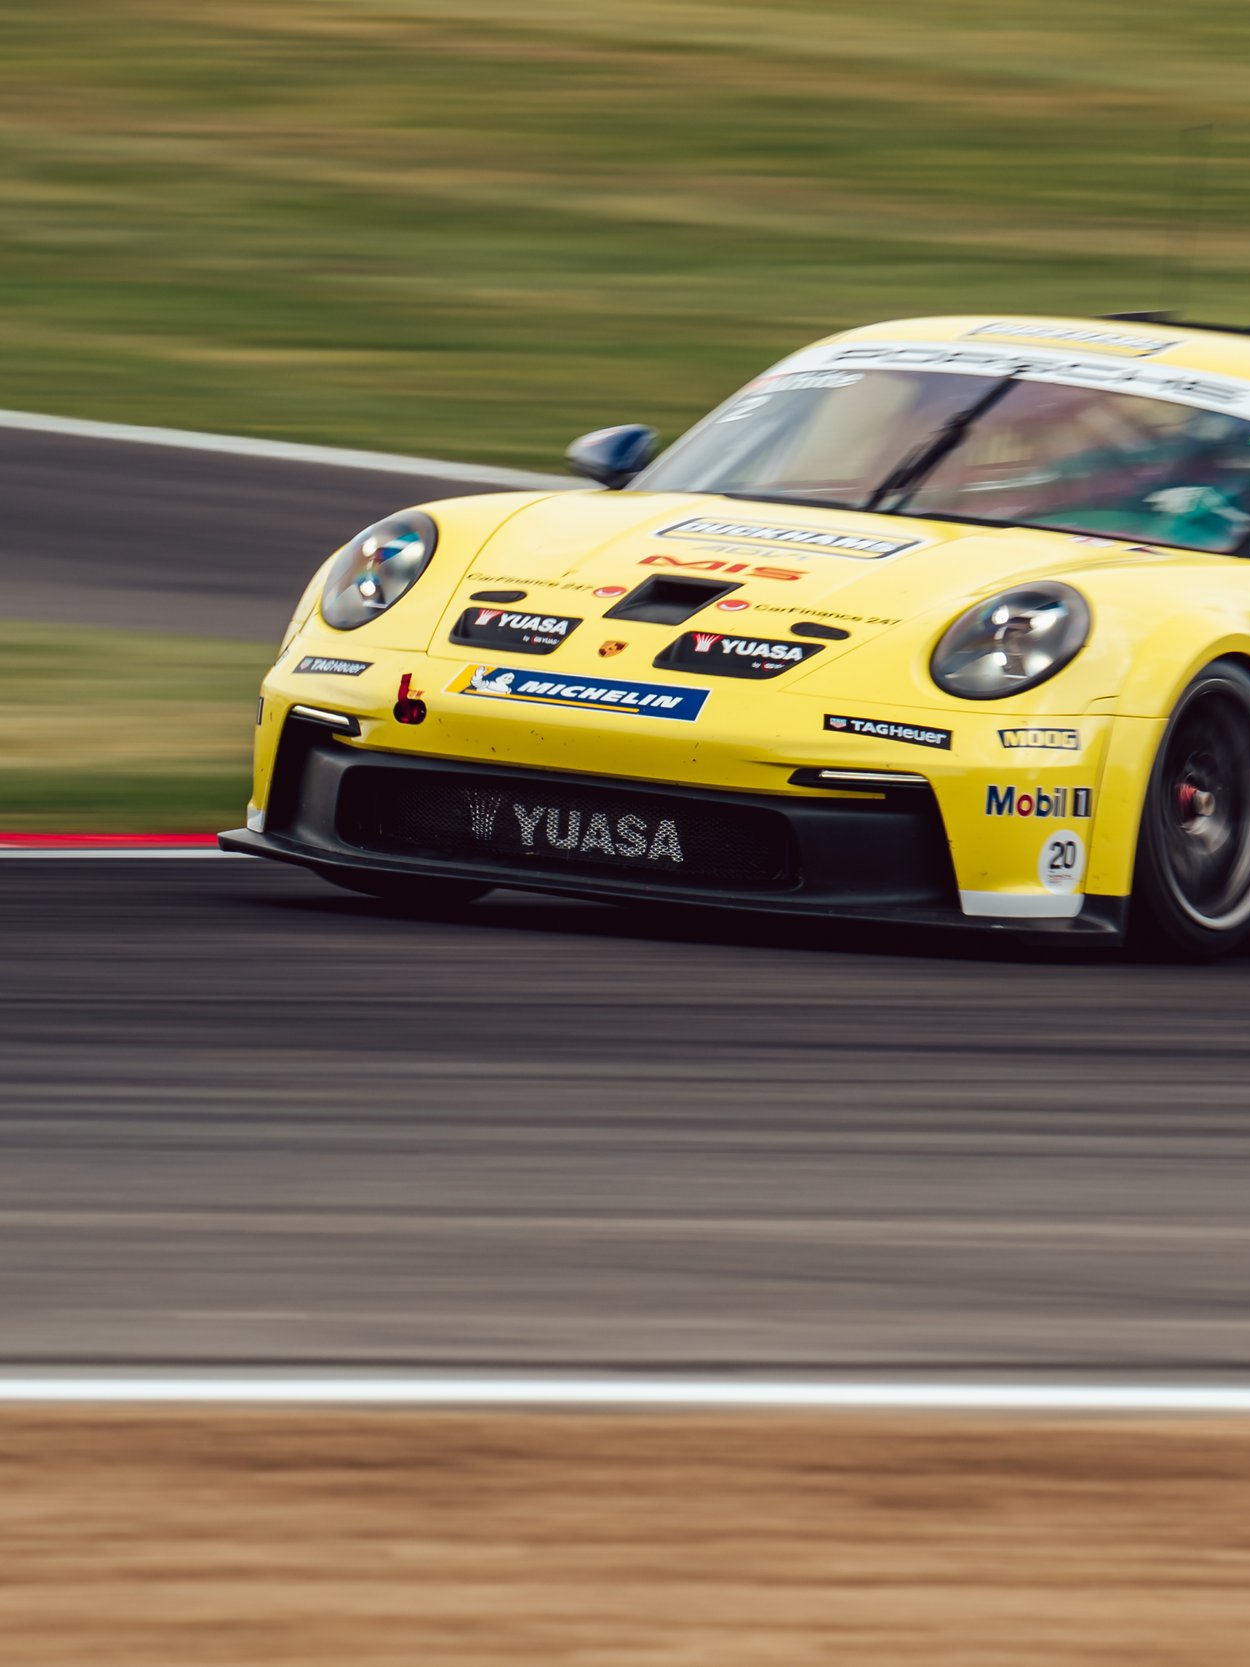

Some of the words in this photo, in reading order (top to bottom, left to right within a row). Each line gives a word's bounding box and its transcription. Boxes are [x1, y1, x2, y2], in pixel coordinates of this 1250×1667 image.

[820, 348, 1248, 402] PORSCHE
[676, 520, 899, 552] DUCKHAMS
[637, 555, 812, 581] MIS
[498, 612, 569, 636] YUASA
[754, 603, 864, 622] CarFinance
[865, 616, 903, 626] 247
[720, 638, 804, 661] YUASA
[516, 680, 683, 709] MICHELIN
[850, 719, 948, 745] TAGHeuer
[1001, 729, 1078, 750] MOOG
[984, 785, 1068, 818] Mobil
[512, 803, 684, 863] YUASA
[1049, 841, 1077, 869] 20
